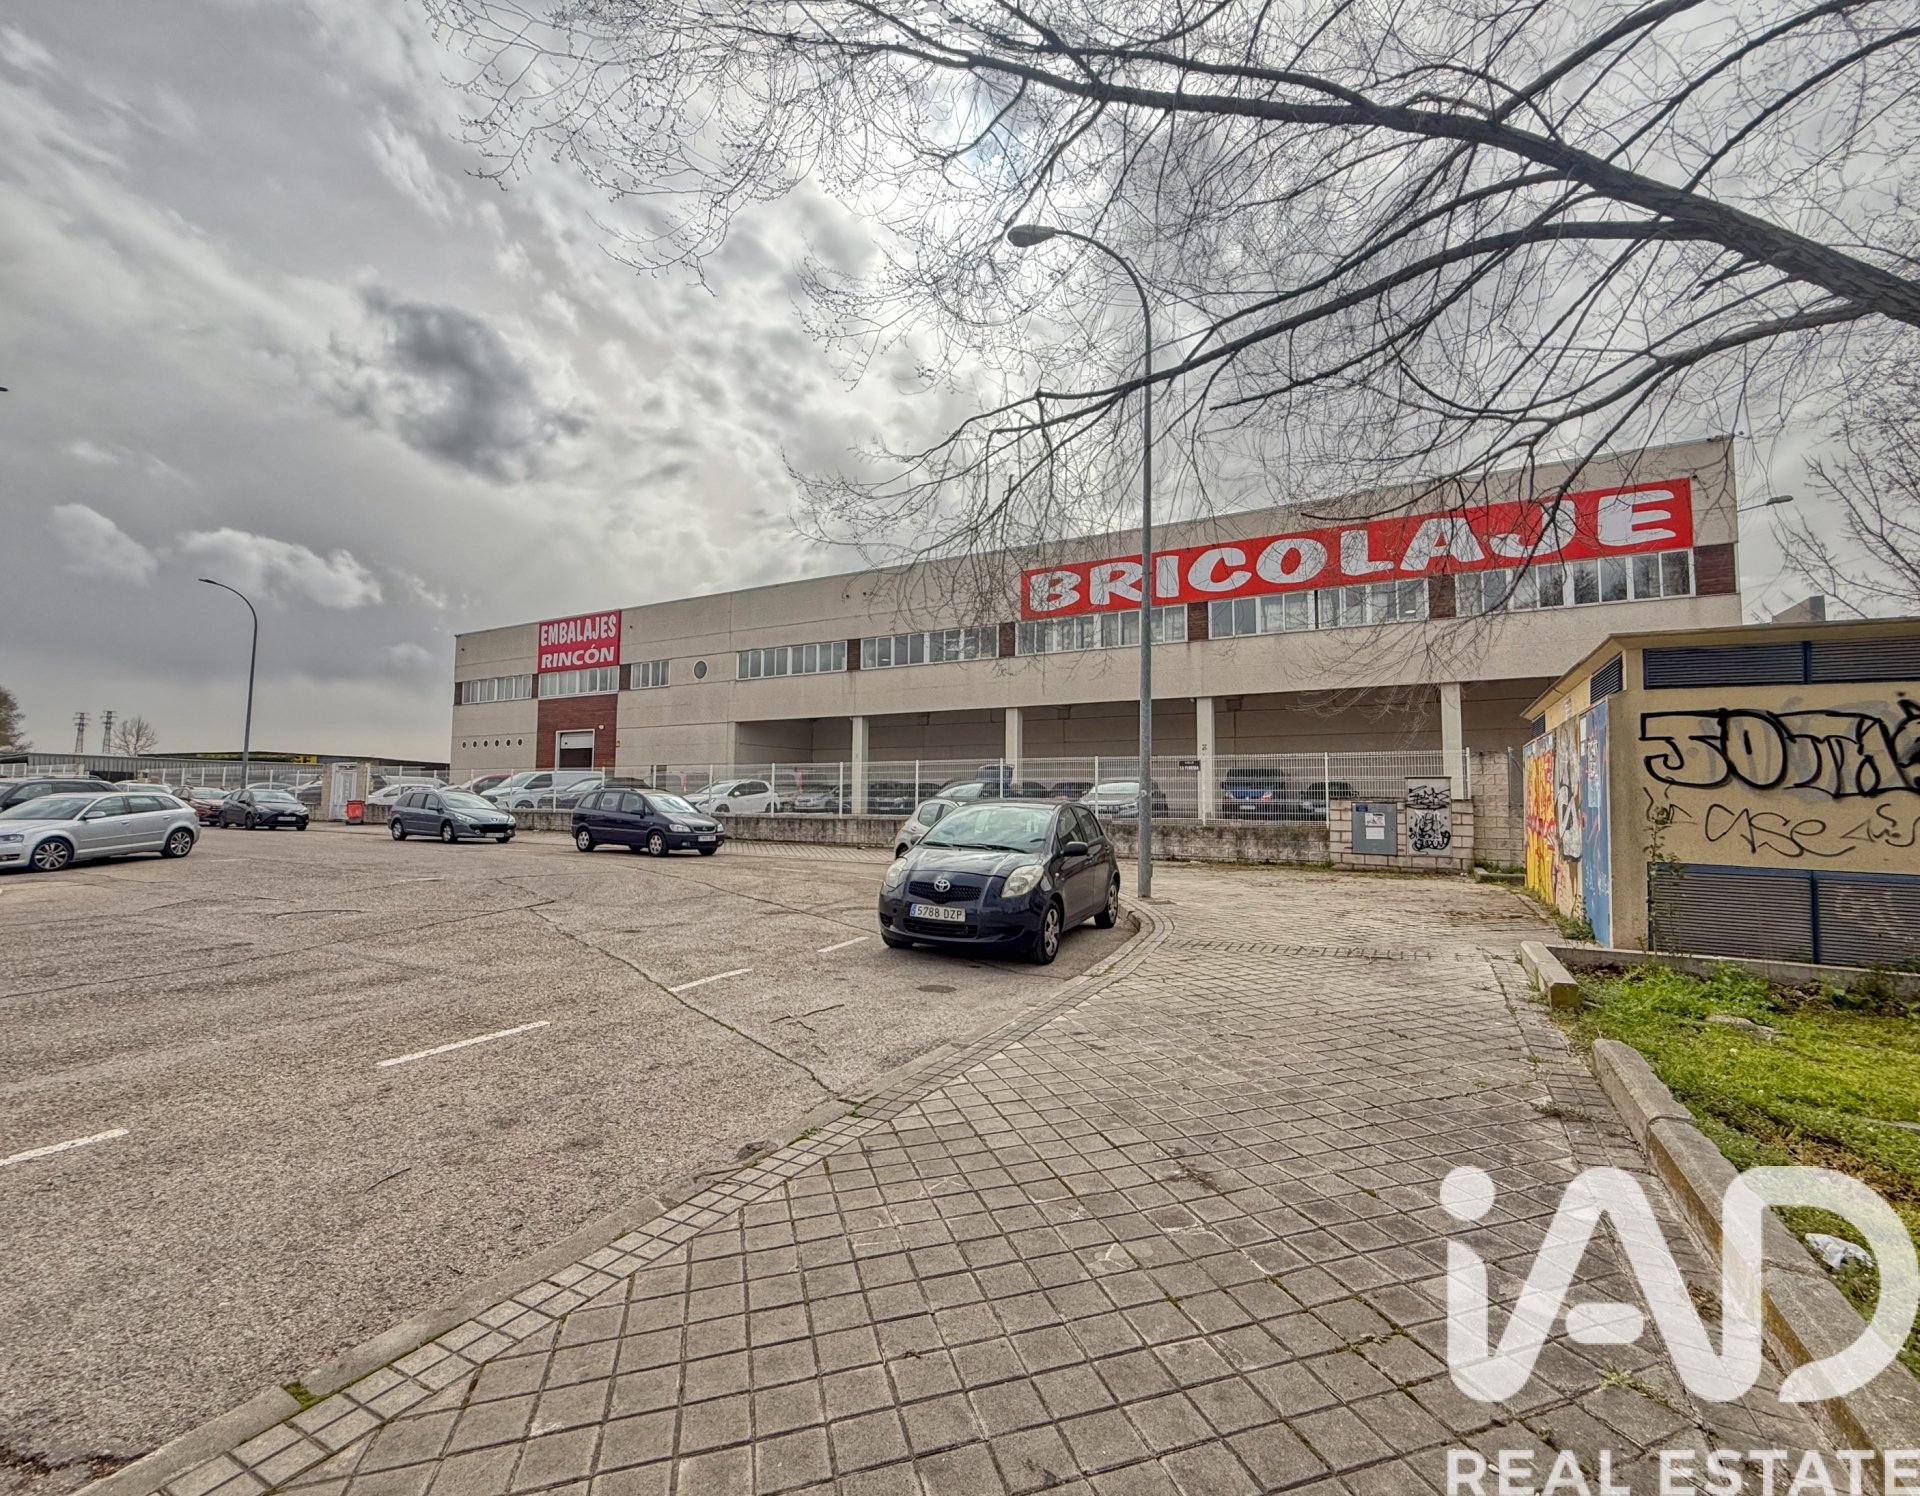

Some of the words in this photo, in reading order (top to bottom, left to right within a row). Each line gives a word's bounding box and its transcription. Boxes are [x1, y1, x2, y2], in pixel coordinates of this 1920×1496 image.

[1029, 489, 1677, 612] BRICOLAJE
[540, 614, 617, 647] EMBALAJES
[541, 644, 615, 669] RINCÓN
[917, 906, 940, 917] 5788
[943, 909, 962, 919] DZP
